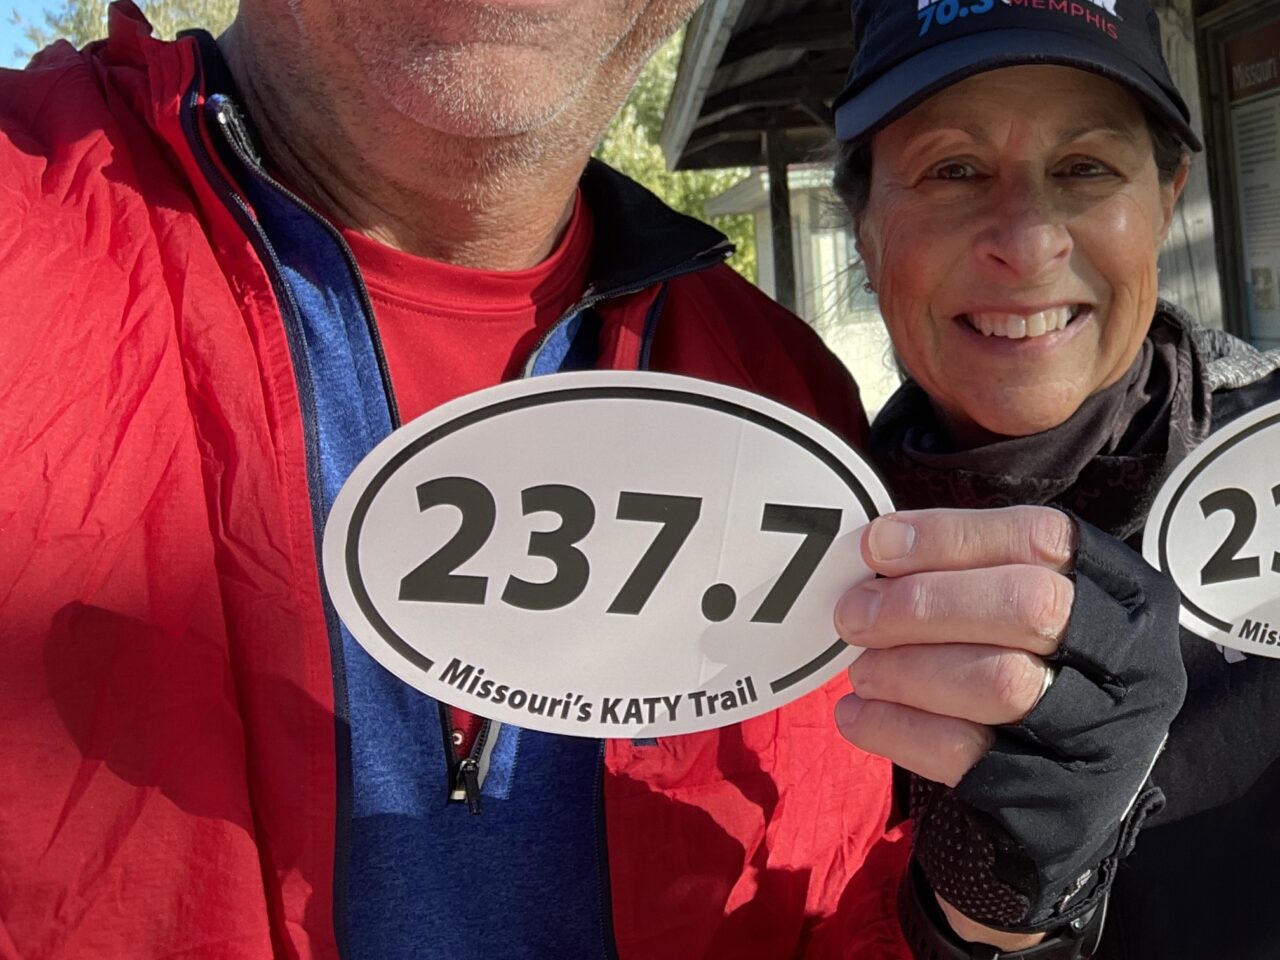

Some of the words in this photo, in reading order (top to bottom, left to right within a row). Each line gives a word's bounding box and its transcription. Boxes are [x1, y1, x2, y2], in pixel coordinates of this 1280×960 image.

[1232, 50, 1278, 91] Missouri
[398, 476, 843, 624] 237.7
[438, 657, 592, 724] Missouri's
[600, 693, 683, 725] KATY
[688, 676, 758, 718] Trail
